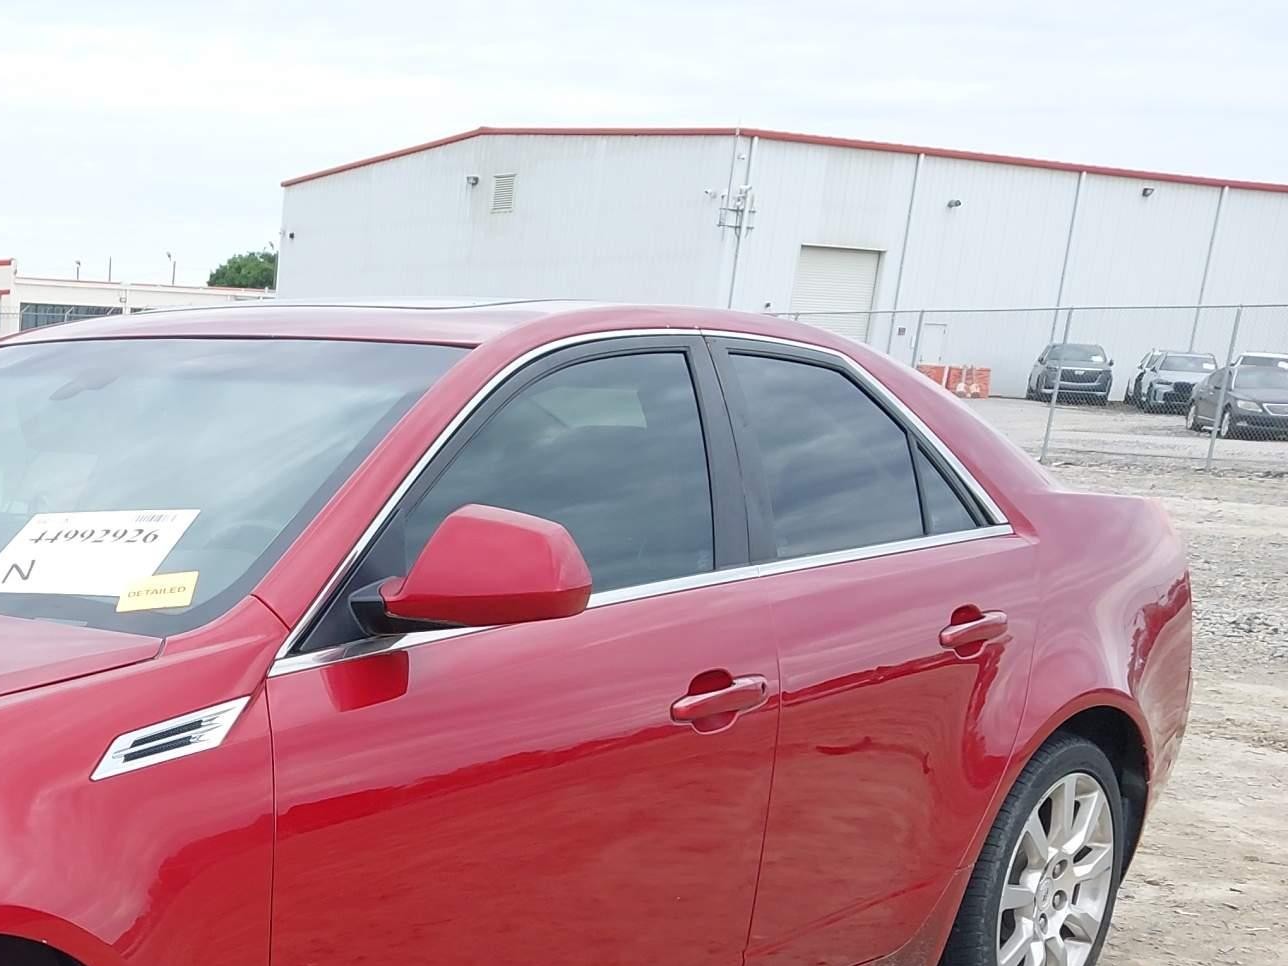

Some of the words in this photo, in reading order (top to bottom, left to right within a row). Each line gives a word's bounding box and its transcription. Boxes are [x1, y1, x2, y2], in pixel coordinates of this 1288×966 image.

[29, 528, 161, 544] 44992926
[1, 559, 36, 585] N
[127, 585, 187, 599] DETAILED
